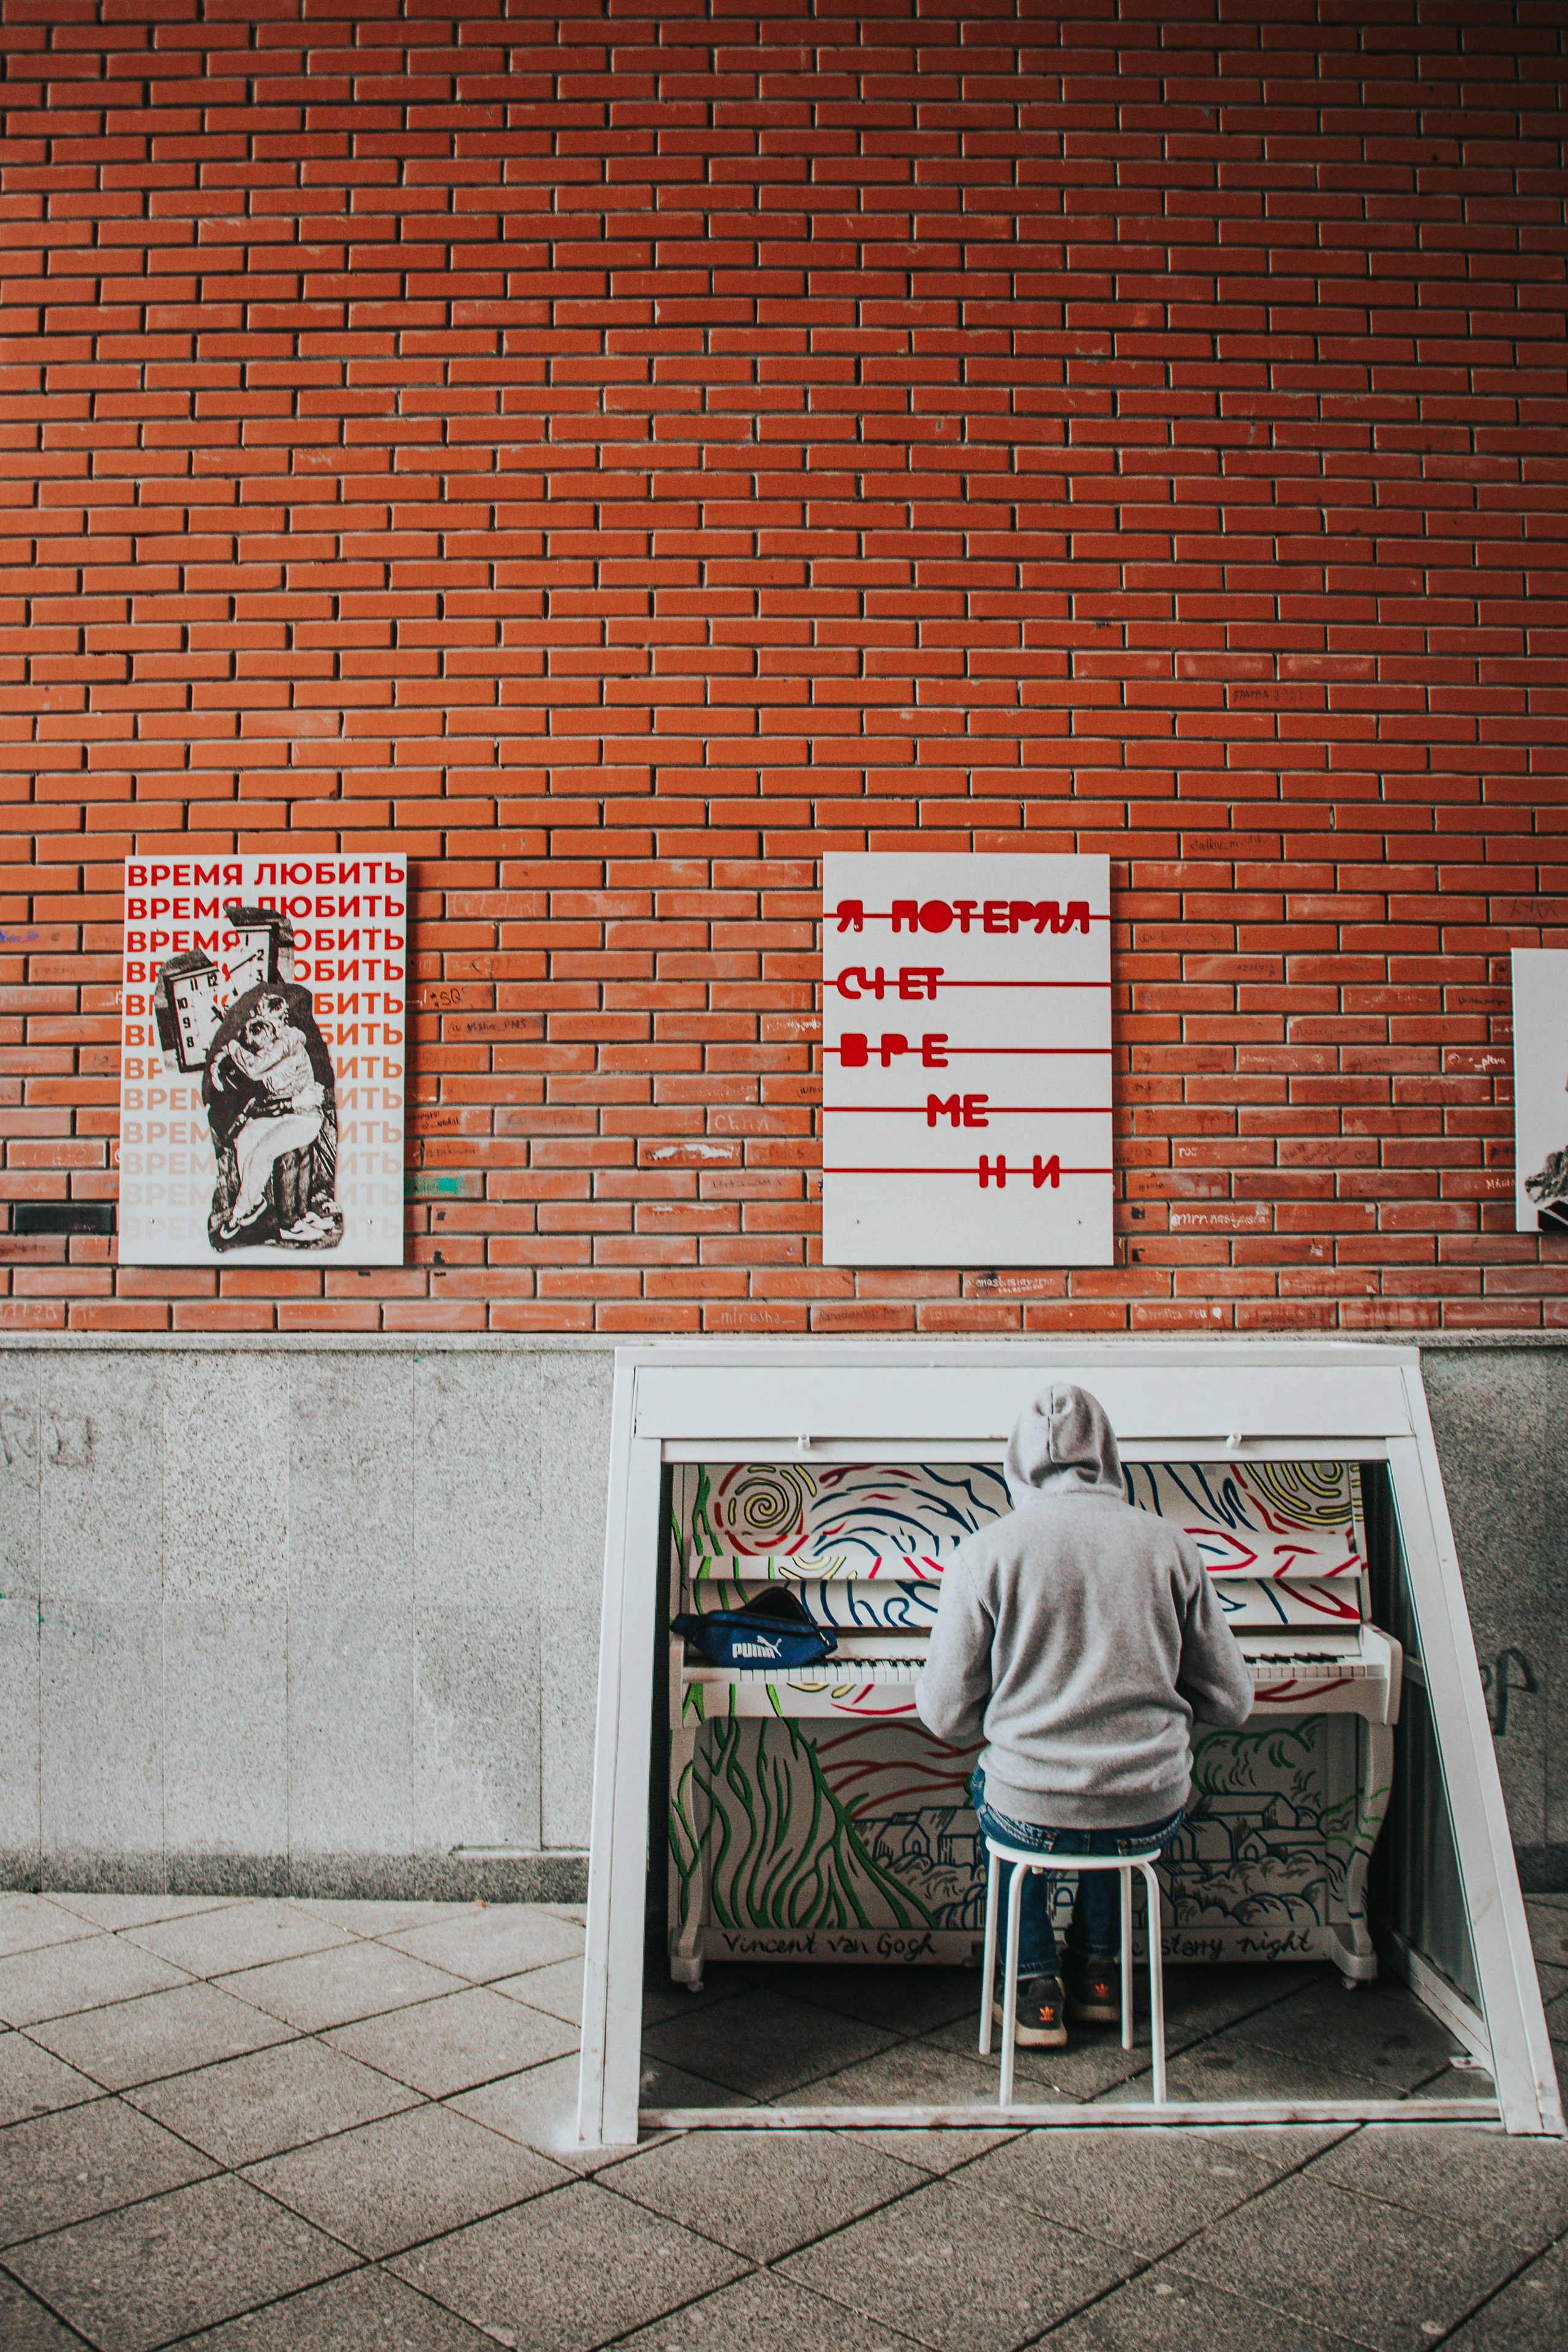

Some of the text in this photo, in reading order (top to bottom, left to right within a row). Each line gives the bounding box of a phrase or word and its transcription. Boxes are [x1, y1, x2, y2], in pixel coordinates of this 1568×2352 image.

[127, 862, 405, 887] ВРЕМЯ ЛЮБИТЬ
[837, 900, 1090, 933] Я ПОТЕРЯЛ
[256, 949, 265, 961] 2
[837, 967, 944, 1000] СЧЕТ
[176, 997, 189, 1010] 10
[314, 992, 403, 1014] БИТЬ
[183, 1016, 191, 1028] 9
[186, 1036, 195, 1048] 8
[317, 1023, 402, 1046] БИТЬ
[840, 1033, 949, 1067] ВРЕ
[334, 1057, 402, 1079] ИТЬ
[336, 1087, 402, 1110] ИТЬ
[927, 1094, 989, 1127] МЕ
[124, 1121, 212, 1144] ВРЕМ
[337, 1121, 402, 1144] ИТЬ
[123, 1152, 216, 1175] ВРЕМ
[123, 1183, 214, 1205] ВРЕМ
[722, 1932, 817, 1955] Vincent
[876, 1932, 937, 1962] Gogh
[1235, 1928, 1316, 1961] night
